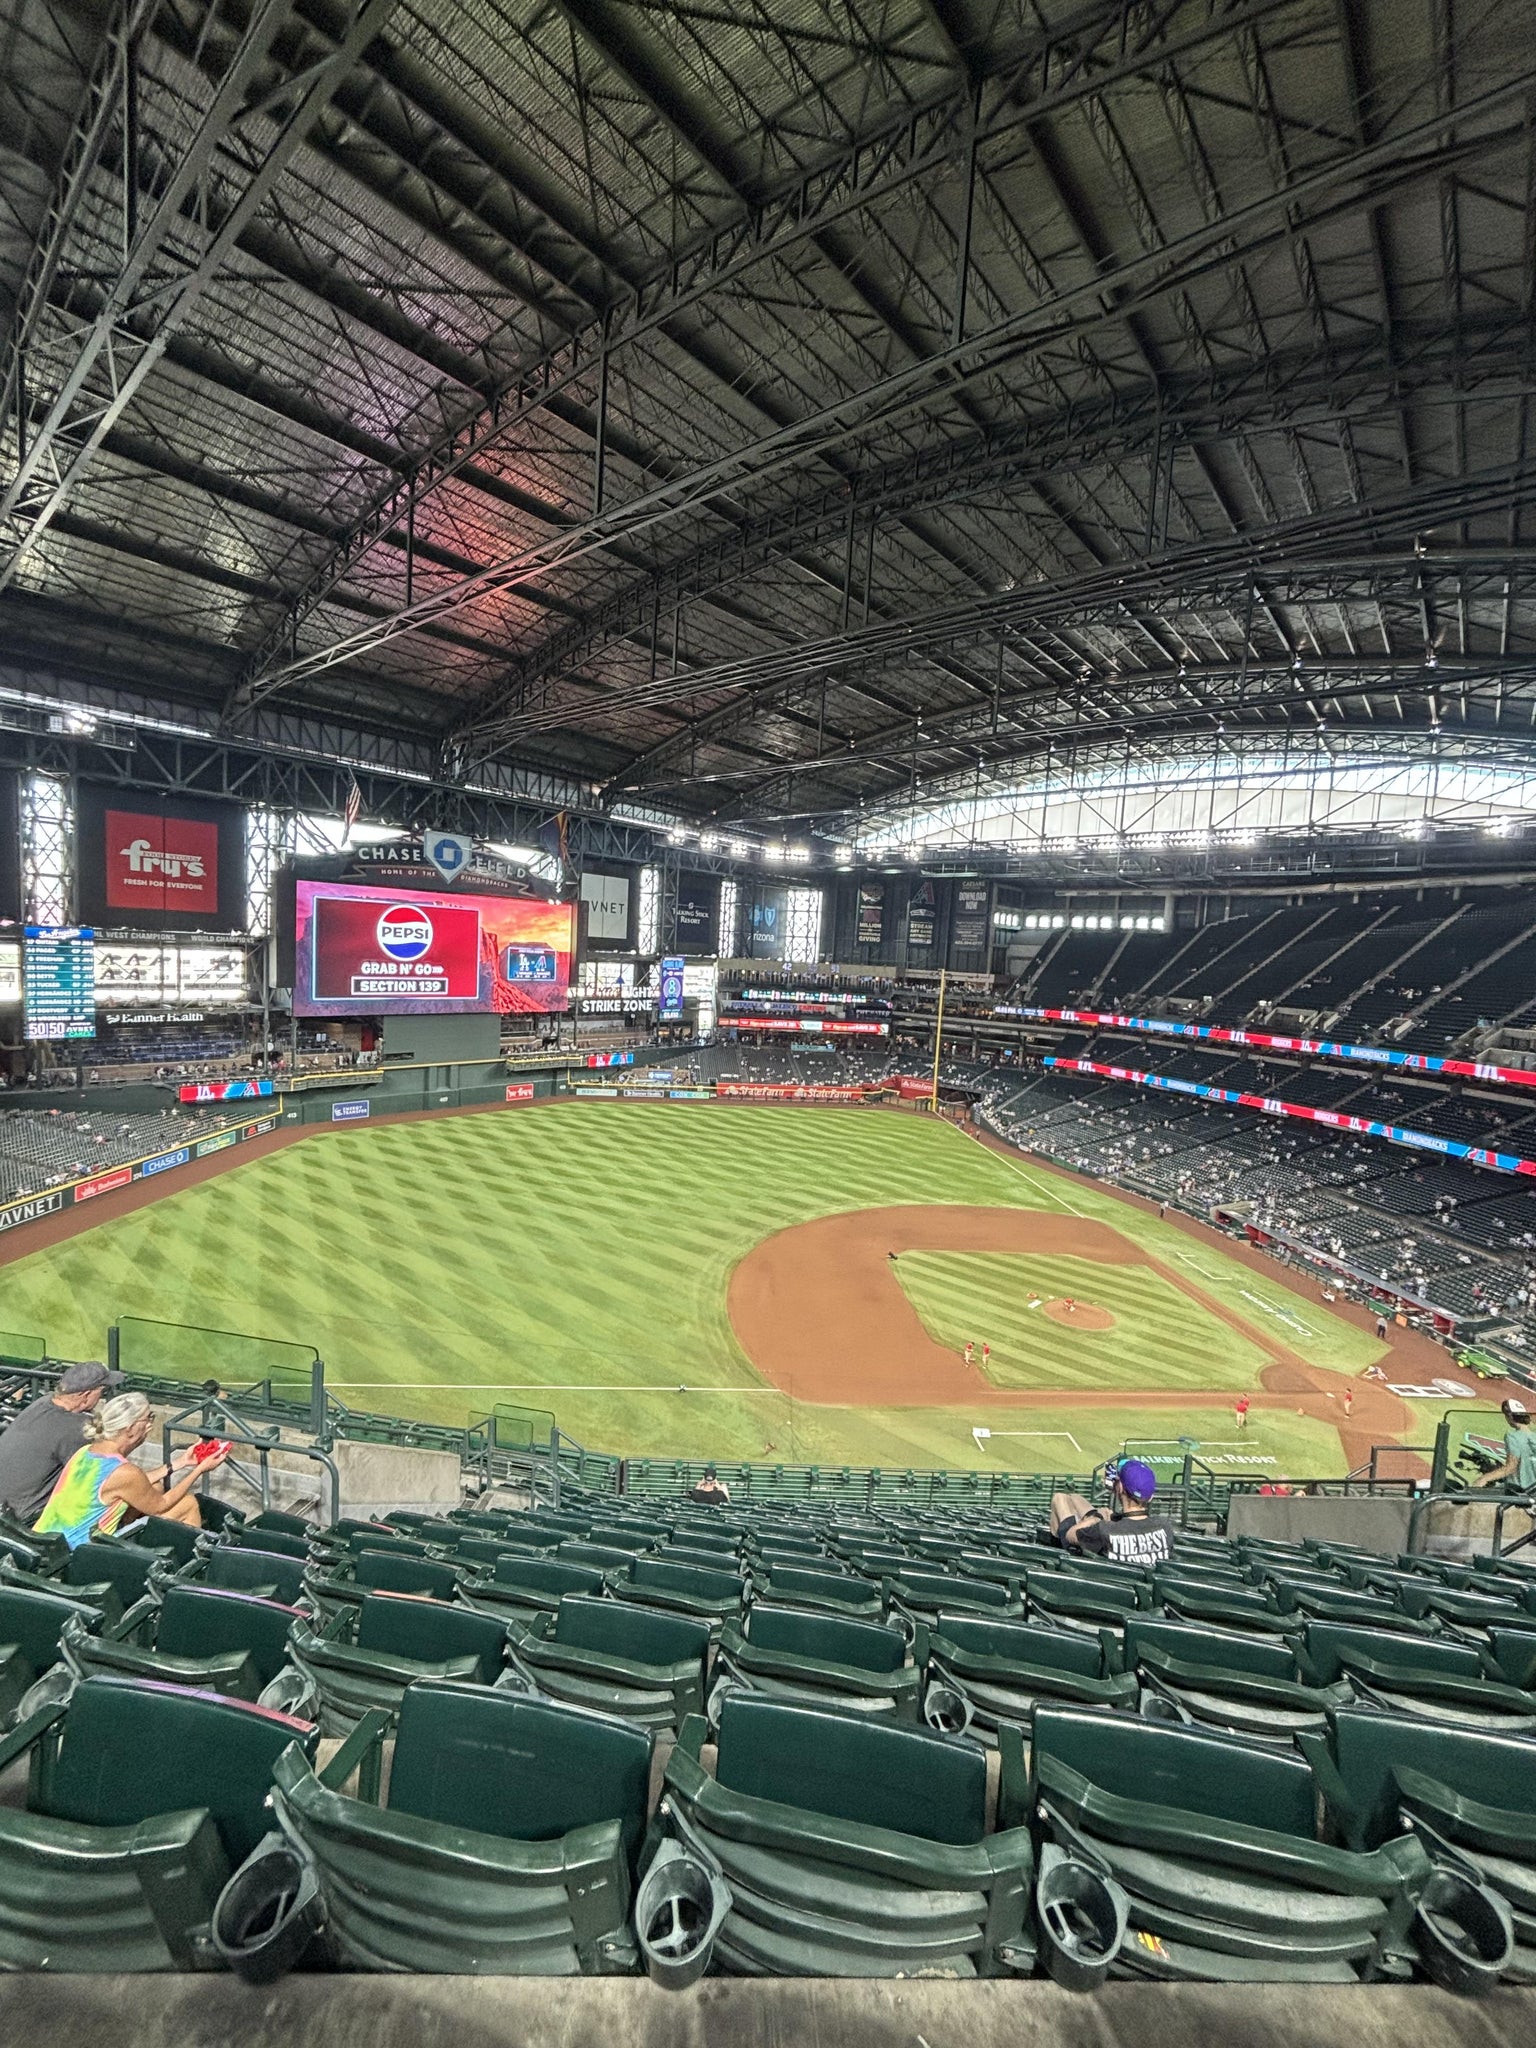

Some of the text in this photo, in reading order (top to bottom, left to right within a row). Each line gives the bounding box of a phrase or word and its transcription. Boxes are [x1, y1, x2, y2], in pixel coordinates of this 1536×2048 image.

[120, 839, 207, 878] fry's
[358, 847, 421, 862] CHASE
[123, 878, 147, 886] FRESH
[166, 881, 203, 891] EVERYONE
[591, 900, 625, 915] VNET
[131, 933, 176, 941] CHAMPIONS
[381, 926, 429, 939] PEPSI
[361, 961, 398, 975] GRAB
[360, 980, 442, 992] SECTION 139
[582, 1000, 653, 1012] STRIKE ZONE
[121, 1013, 165, 1022] Banner
[149, 1156, 177, 1171] CHASE
[1109, 1528, 1168, 1555] THE BEST
